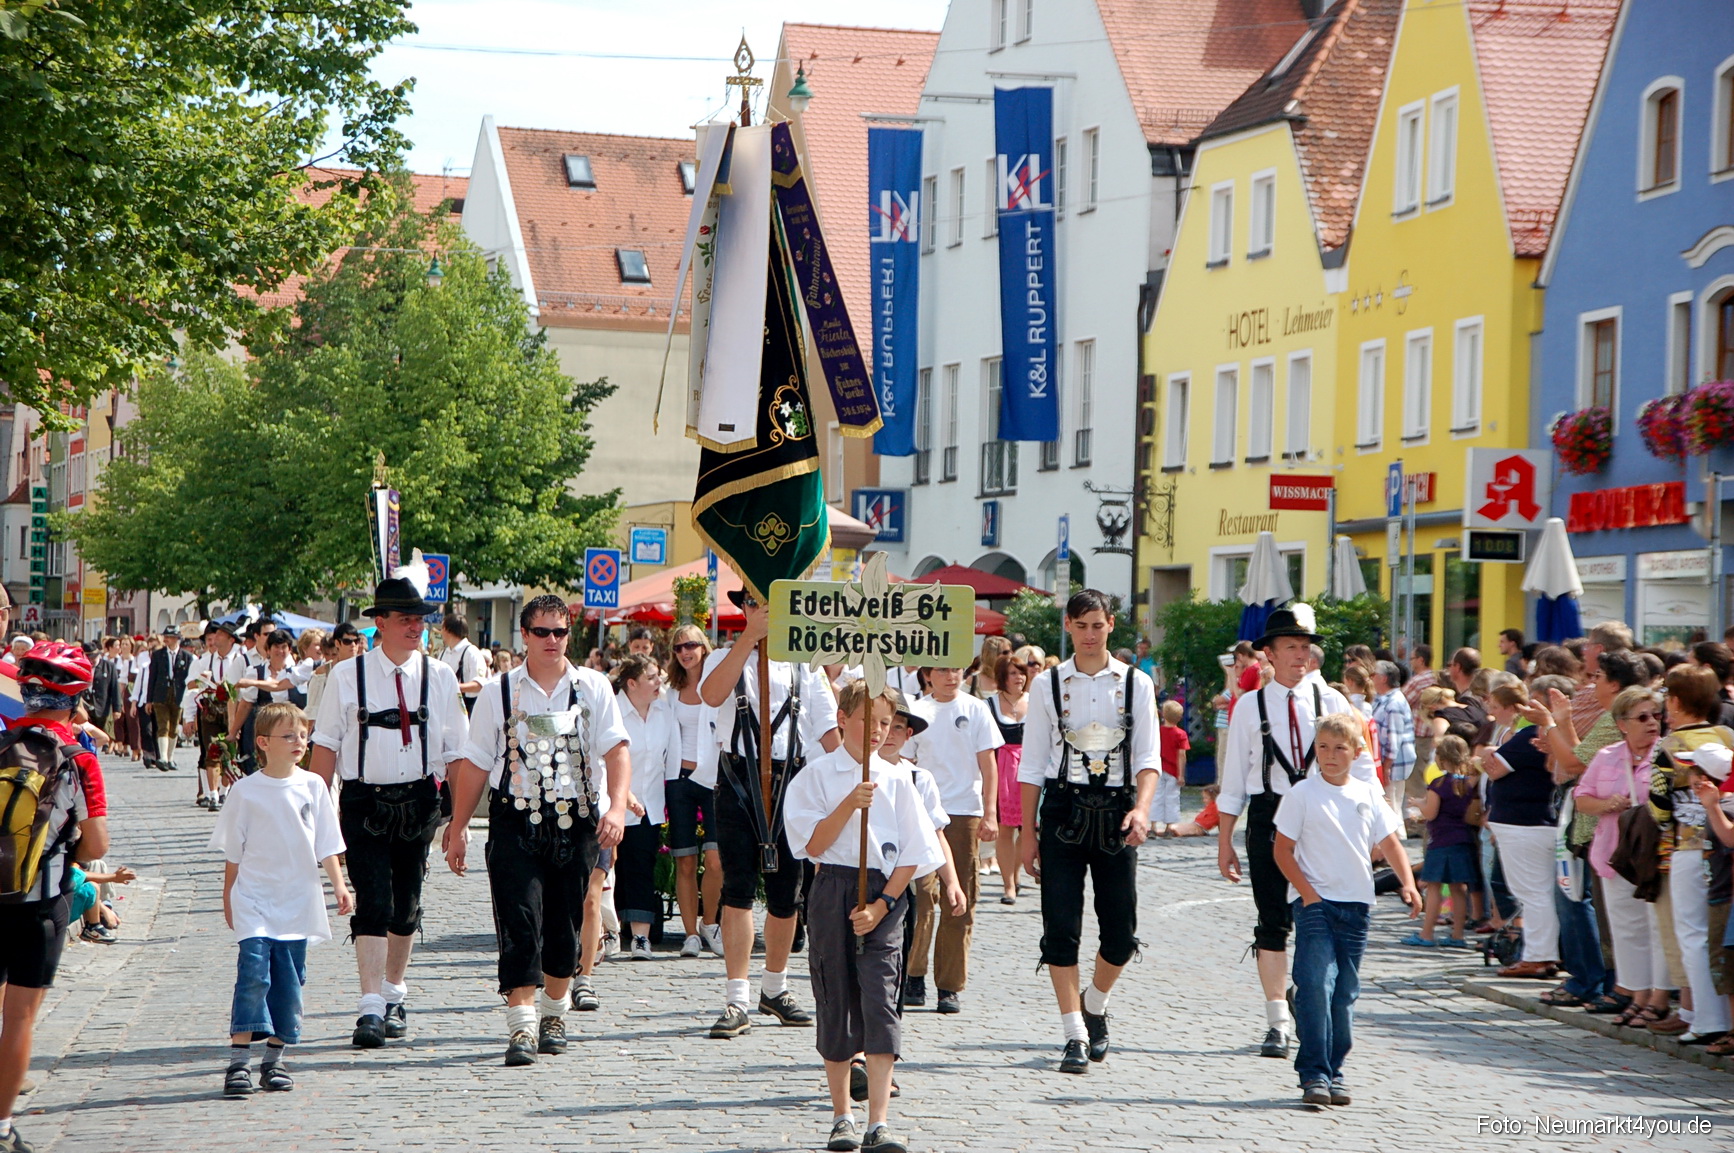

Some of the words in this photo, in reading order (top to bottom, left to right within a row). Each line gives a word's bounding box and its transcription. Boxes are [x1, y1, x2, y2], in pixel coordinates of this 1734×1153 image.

[1026, 221, 1047, 342] RUPPERT
[1229, 308, 1271, 349] HOTEL
[1284, 301, 1335, 336] Lehmeier
[1029, 349, 1048, 398] K&L
[1218, 508, 1279, 536] Restaurant
[31, 487, 44, 601] APOTHEKE
[426, 587, 445, 599] AXI
[587, 589, 616, 604] TAXI
[789, 589, 904, 618] Edelweiß
[918, 593, 952, 620] 64
[788, 625, 949, 656] Röckersbühl
